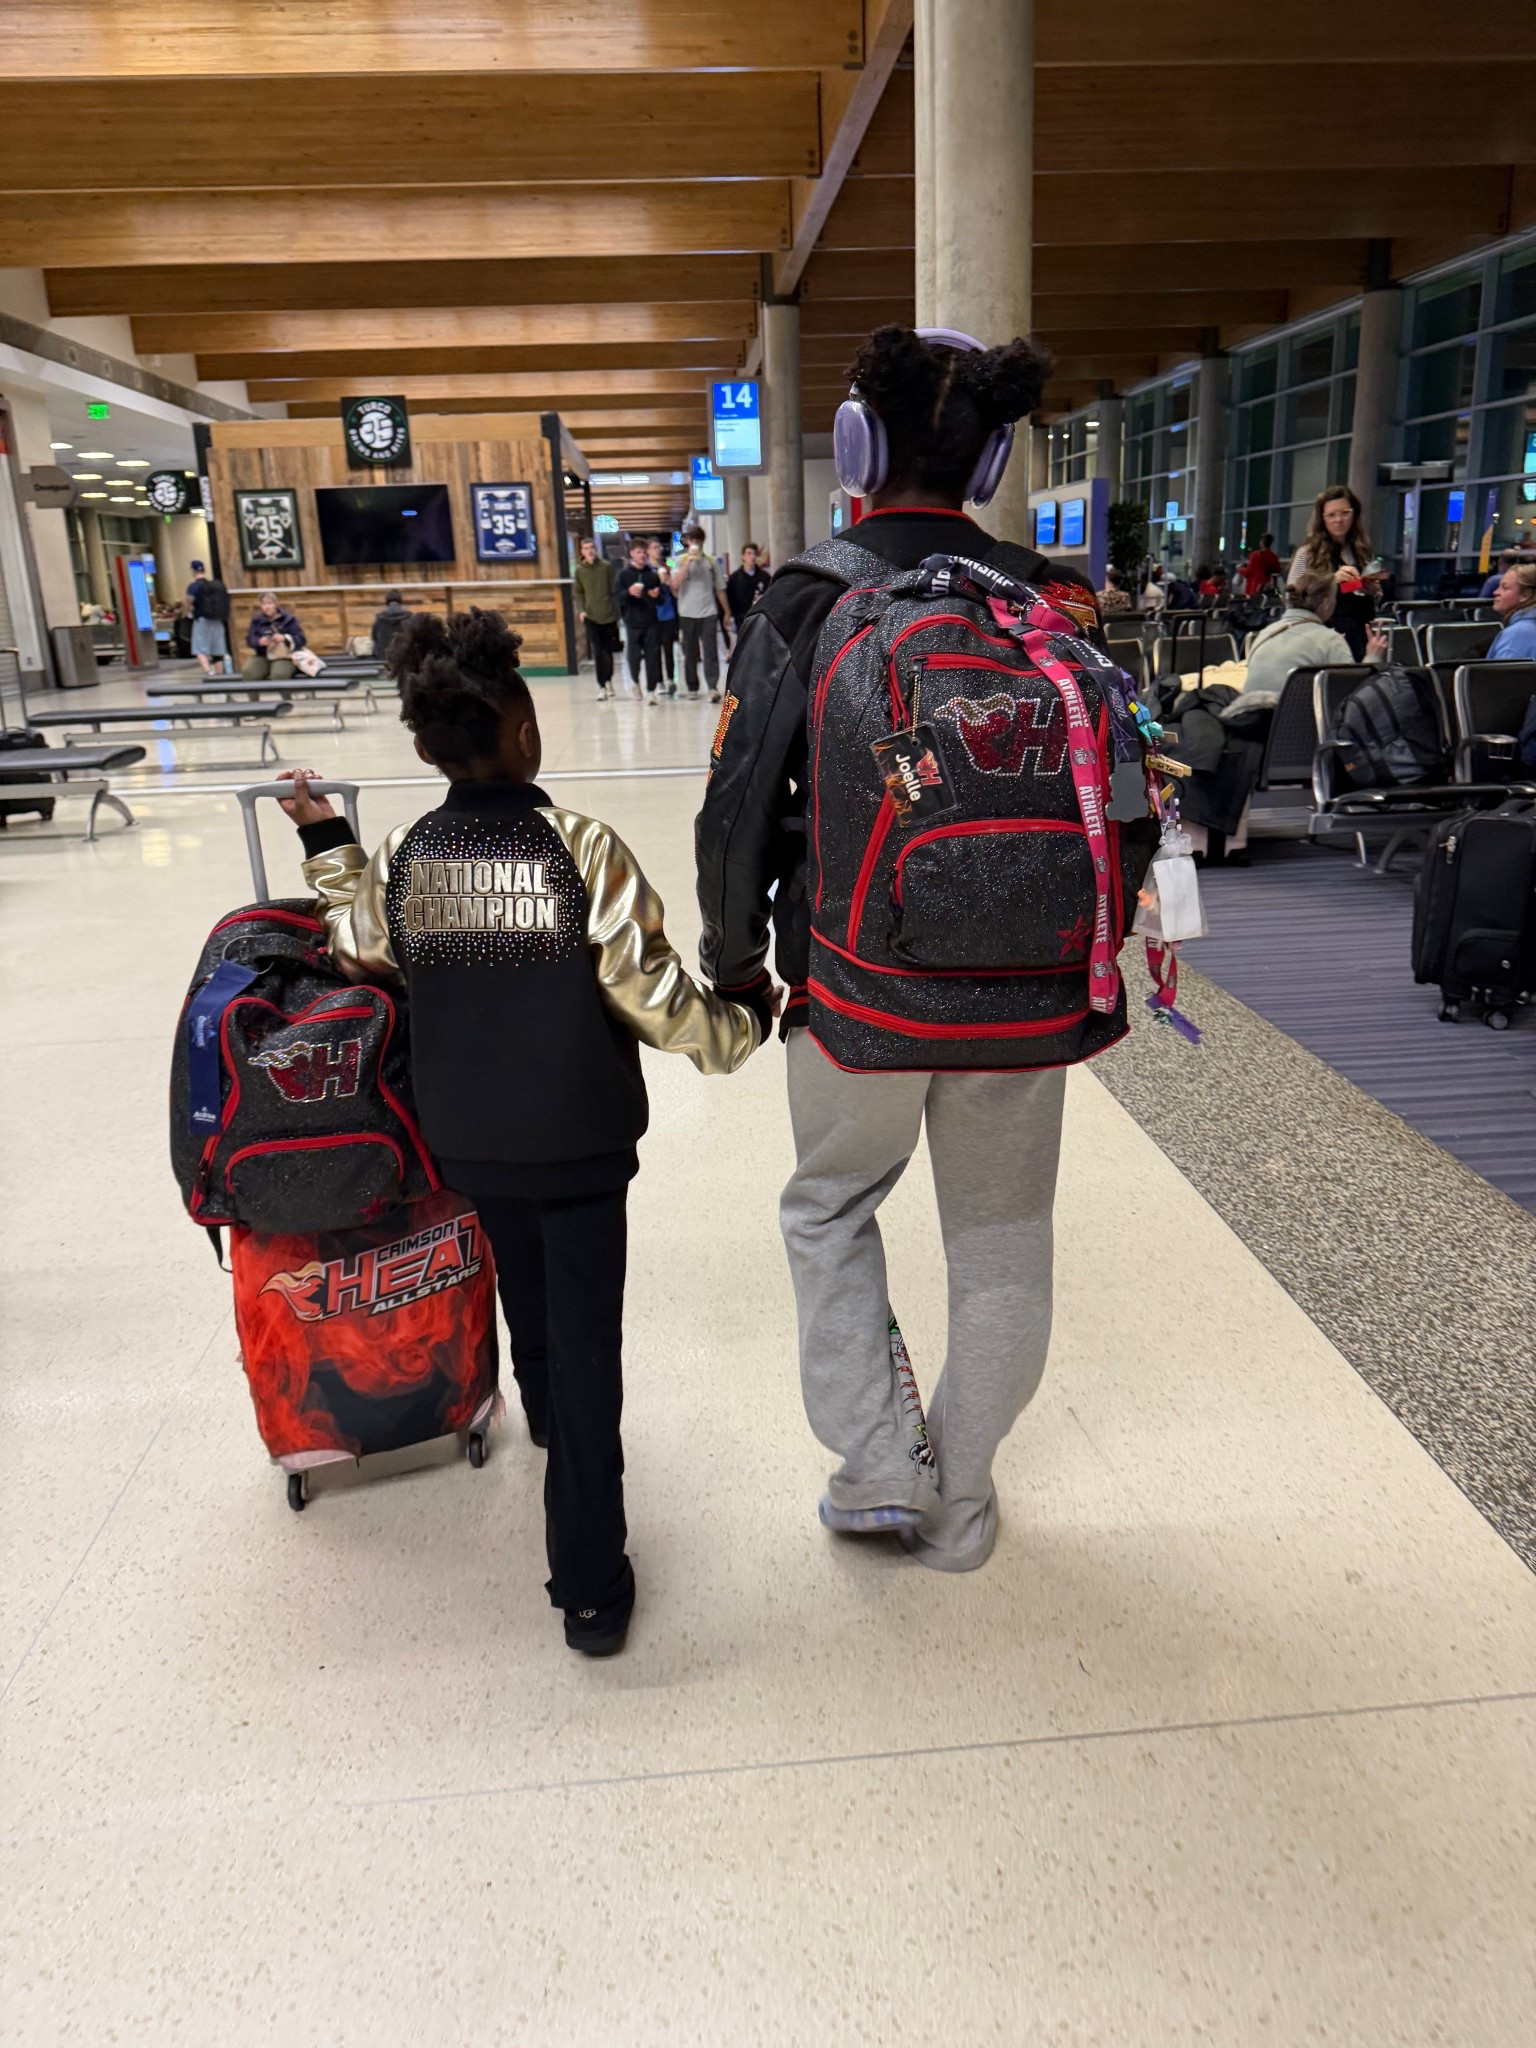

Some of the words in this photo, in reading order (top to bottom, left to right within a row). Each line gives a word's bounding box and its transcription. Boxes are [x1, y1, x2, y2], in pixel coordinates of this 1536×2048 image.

[356, 401, 392, 415] TURCO
[720, 383, 753, 409] 14
[358, 411, 394, 449] 35
[371, 449, 392, 459] AND
[254, 515, 285, 541] 35
[491, 513, 517, 535] 35
[1056, 677, 1084, 729] ATHLETE
[895, 753, 922, 802] Joelle
[1078, 785, 1102, 838] ATHLETE
[411, 859, 549, 895] NATIONAL
[405, 896, 557, 932] CHAMPION
[1095, 893, 1109, 944] ATHLETE
[377, 1221, 456, 1263] CRIMSON
[579, 1608, 598, 1619] UGG
